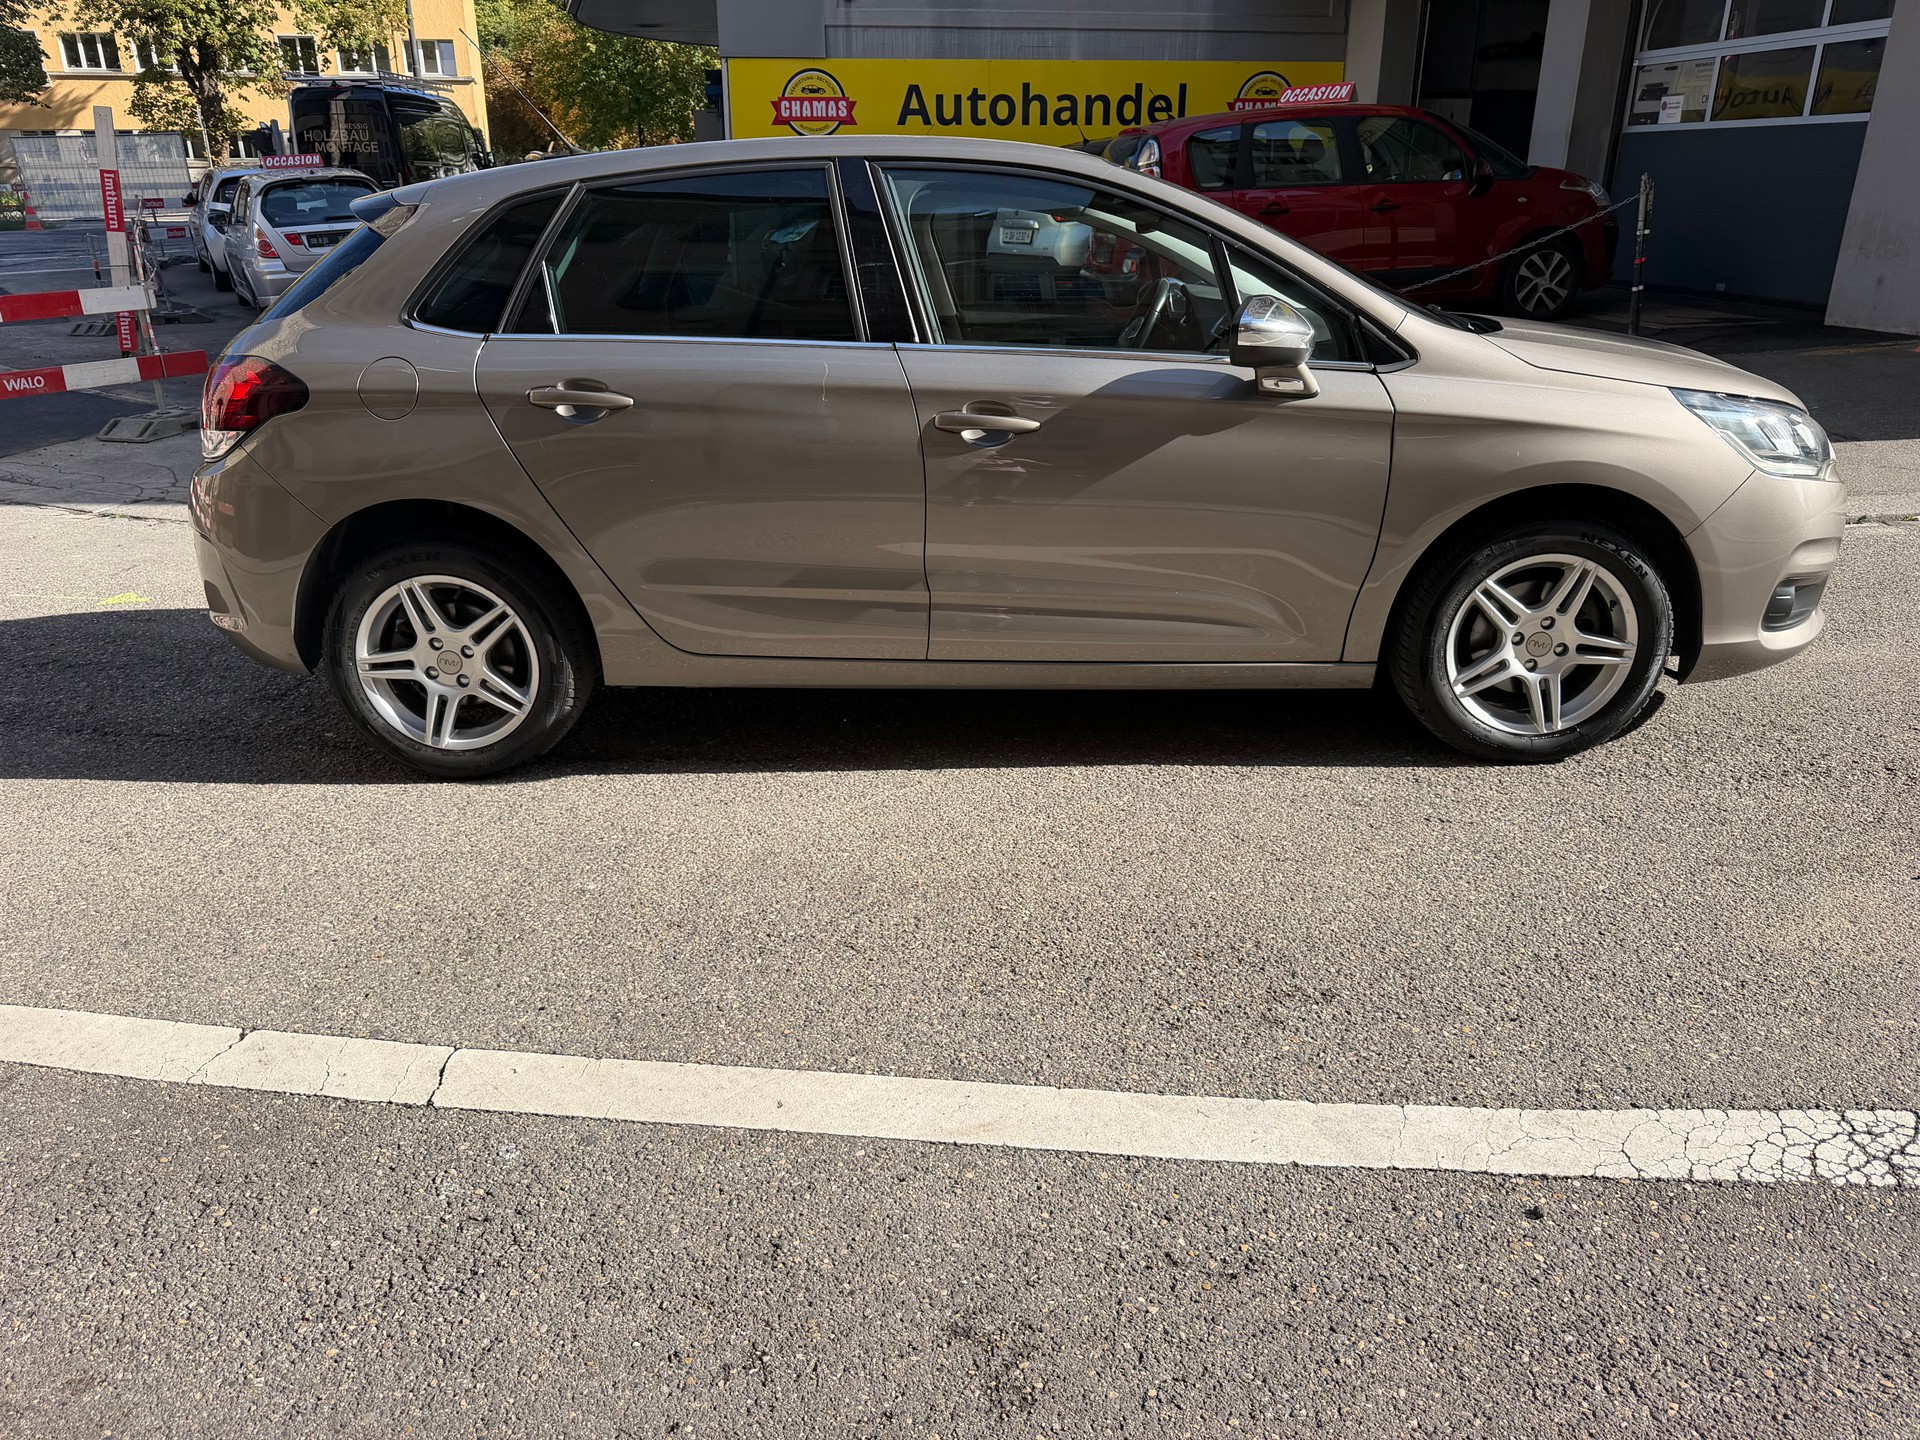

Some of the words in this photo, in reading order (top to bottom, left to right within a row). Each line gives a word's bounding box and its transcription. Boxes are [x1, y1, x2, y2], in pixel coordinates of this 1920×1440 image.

[816, 76, 838, 95] RECYCLING
[1280, 84, 1352, 103] OCCASION
[780, 100, 848, 118] CHAMAS
[897, 82, 1188, 126] Autohandel
[303, 129, 370, 142] HOLZBAU
[799, 123, 831, 133] AUTOHANDEL
[315, 141, 380, 153] MONTAGE
[265, 154, 321, 167] OCCASION
[103, 172, 119, 229] Imthurn
[119, 311, 132, 349] thurn
[3, 375, 45, 392] WALO
[1579, 532, 1650, 580] NEXEN
[364, 551, 441, 582] NEXEN
